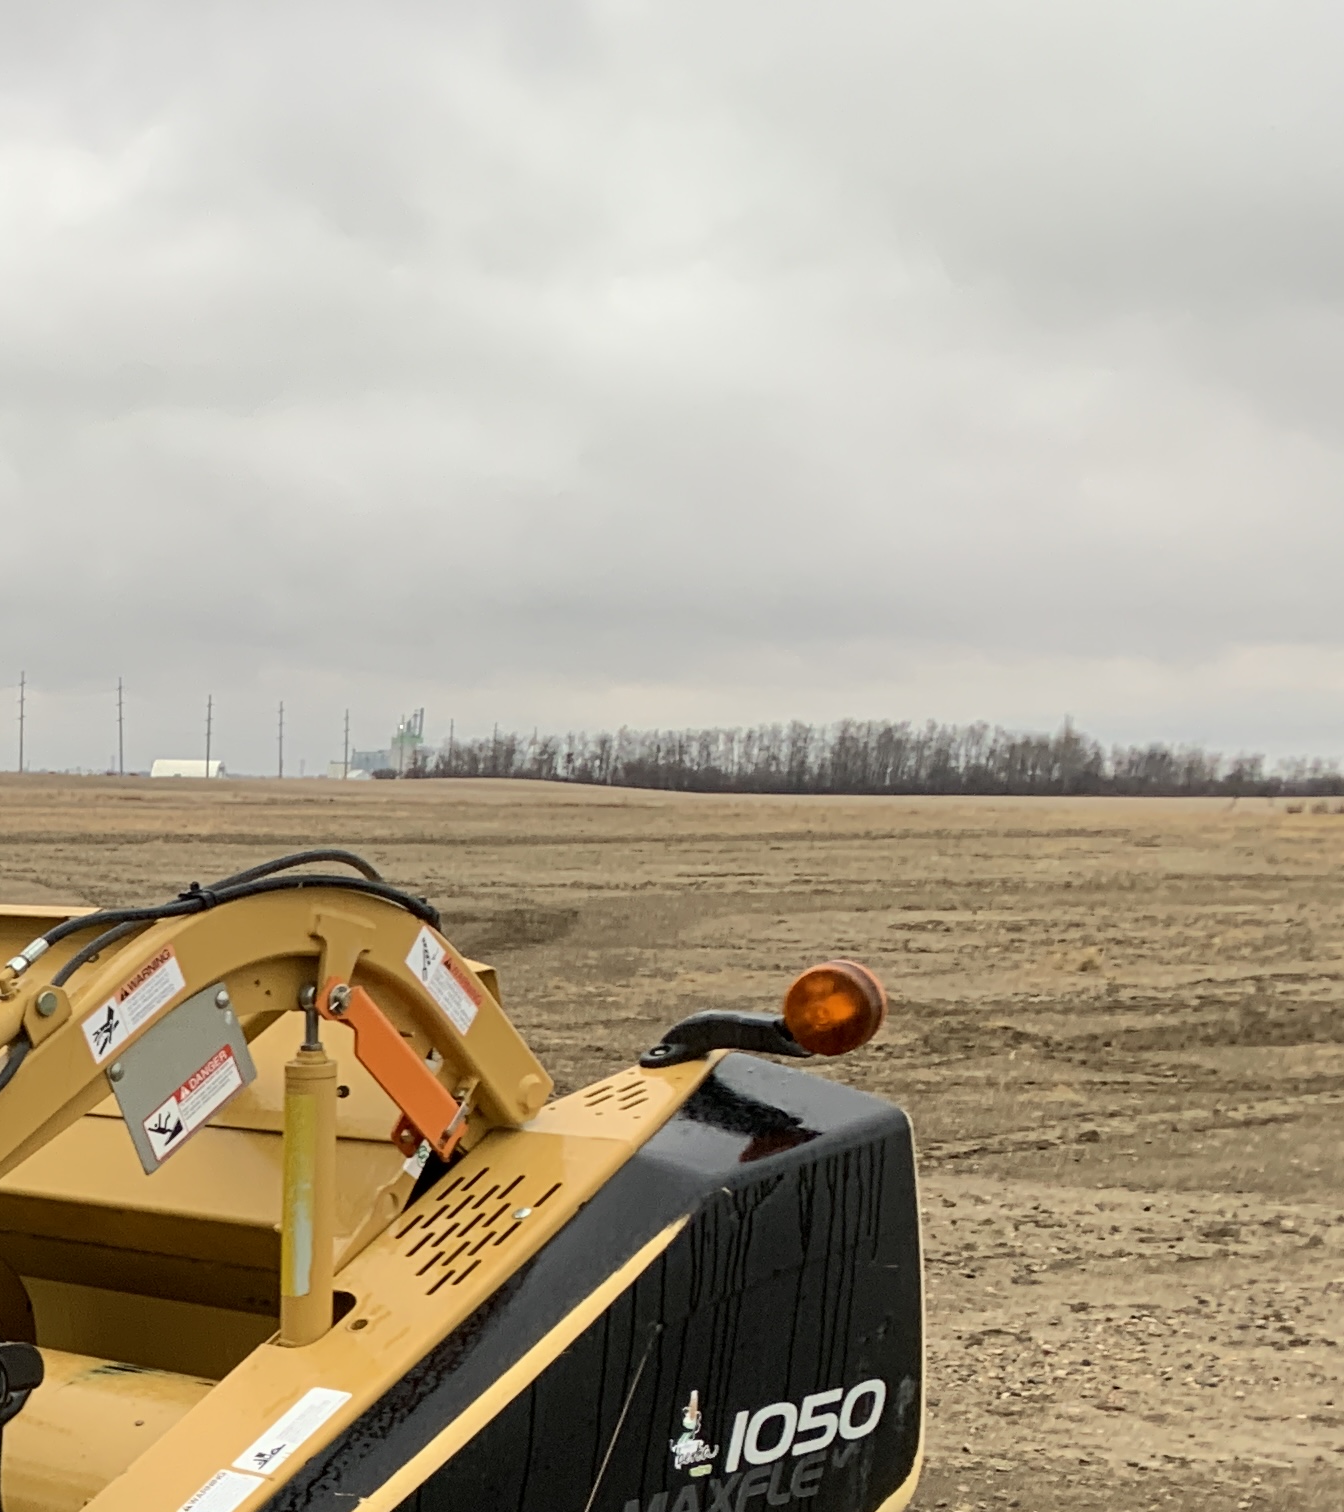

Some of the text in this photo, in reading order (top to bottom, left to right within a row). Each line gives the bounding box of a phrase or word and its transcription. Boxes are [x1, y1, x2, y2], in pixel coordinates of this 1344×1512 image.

[126, 948, 171, 992] WARNING
[188, 1049, 228, 1090] DANGER
[725, 1378, 887, 1474] 1050
